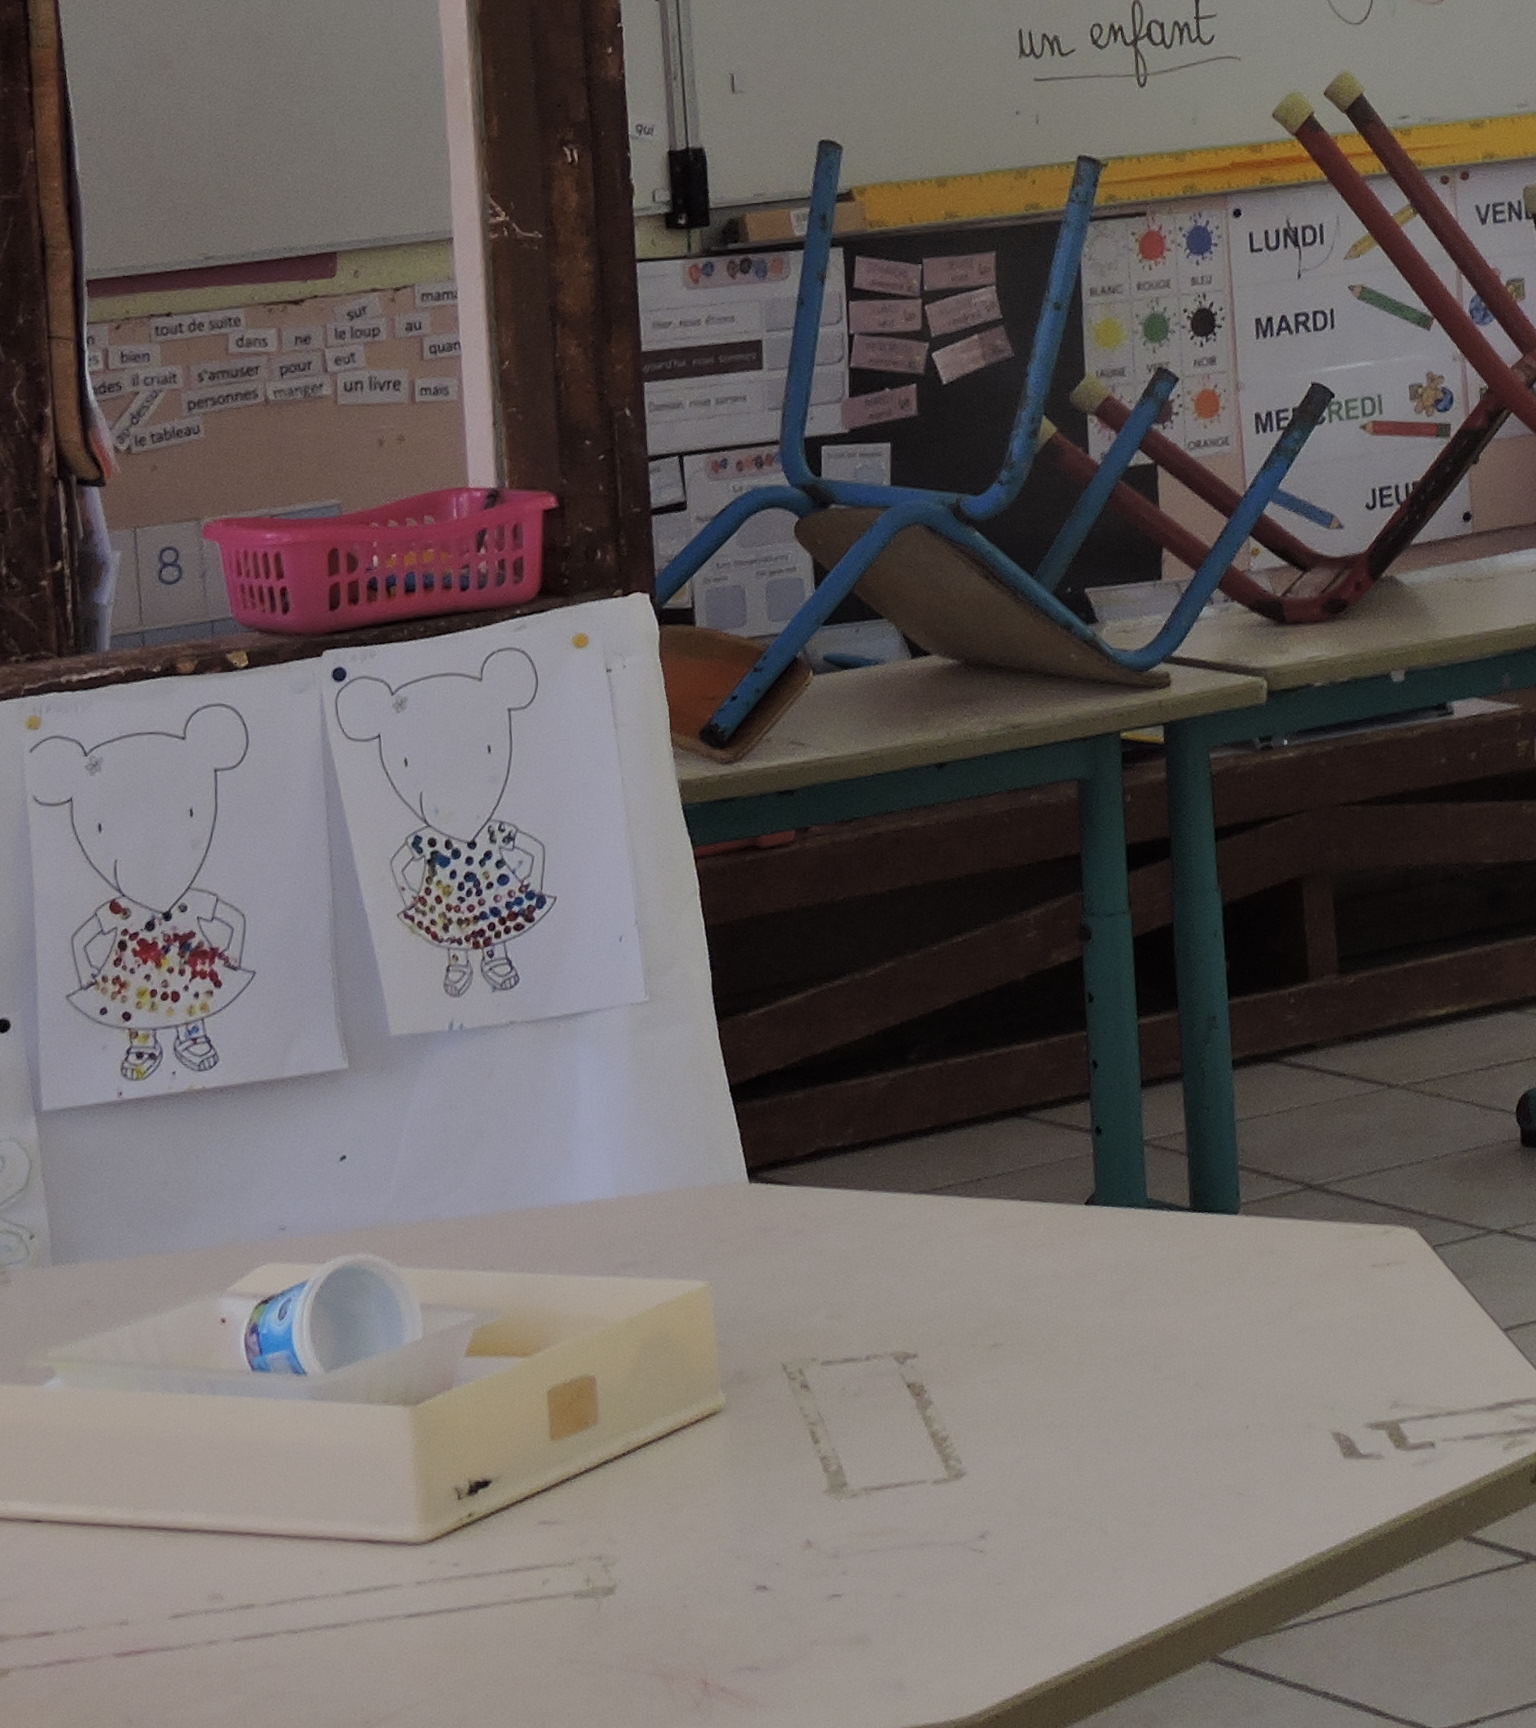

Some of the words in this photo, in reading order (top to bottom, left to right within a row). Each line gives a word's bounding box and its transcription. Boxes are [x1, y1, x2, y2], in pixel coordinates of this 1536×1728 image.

[1018, 25, 1076, 60] un
[635, 124, 655, 139] qui
[1248, 222, 1326, 256] LUNDI
[1136, 278, 1172, 292] ROUGE
[1191, 274, 1213, 287] BLEU
[1088, 283, 1124, 298] BLANC
[345, 304, 369, 321] sur
[154, 324, 185, 337] tout
[187, 319, 206, 332] de
[209, 314, 243, 330] suite
[404, 320, 424, 333] au
[1254, 308, 1337, 341] MARDI
[235, 333, 269, 349] dans
[294, 333, 312, 347] ne
[334, 327, 347, 341] le
[350, 325, 382, 341] loup
[120, 349, 151, 364] bien
[333, 352, 357, 367] eut
[1192, 355, 1217, 368] NOIR
[197, 363, 261, 383] s'amuser
[279, 359, 313, 379] pour
[271, 382, 325, 400] manger
[343, 380, 364, 393] un
[367, 375, 402, 393] livre
[418, 383, 451, 397] mais
[186, 387, 260, 412] personnes
[134, 435, 146, 448] le
[149, 423, 202, 445] tableau
[1187, 436, 1231, 451] ORANGE
[157, 545, 184, 586] 8
